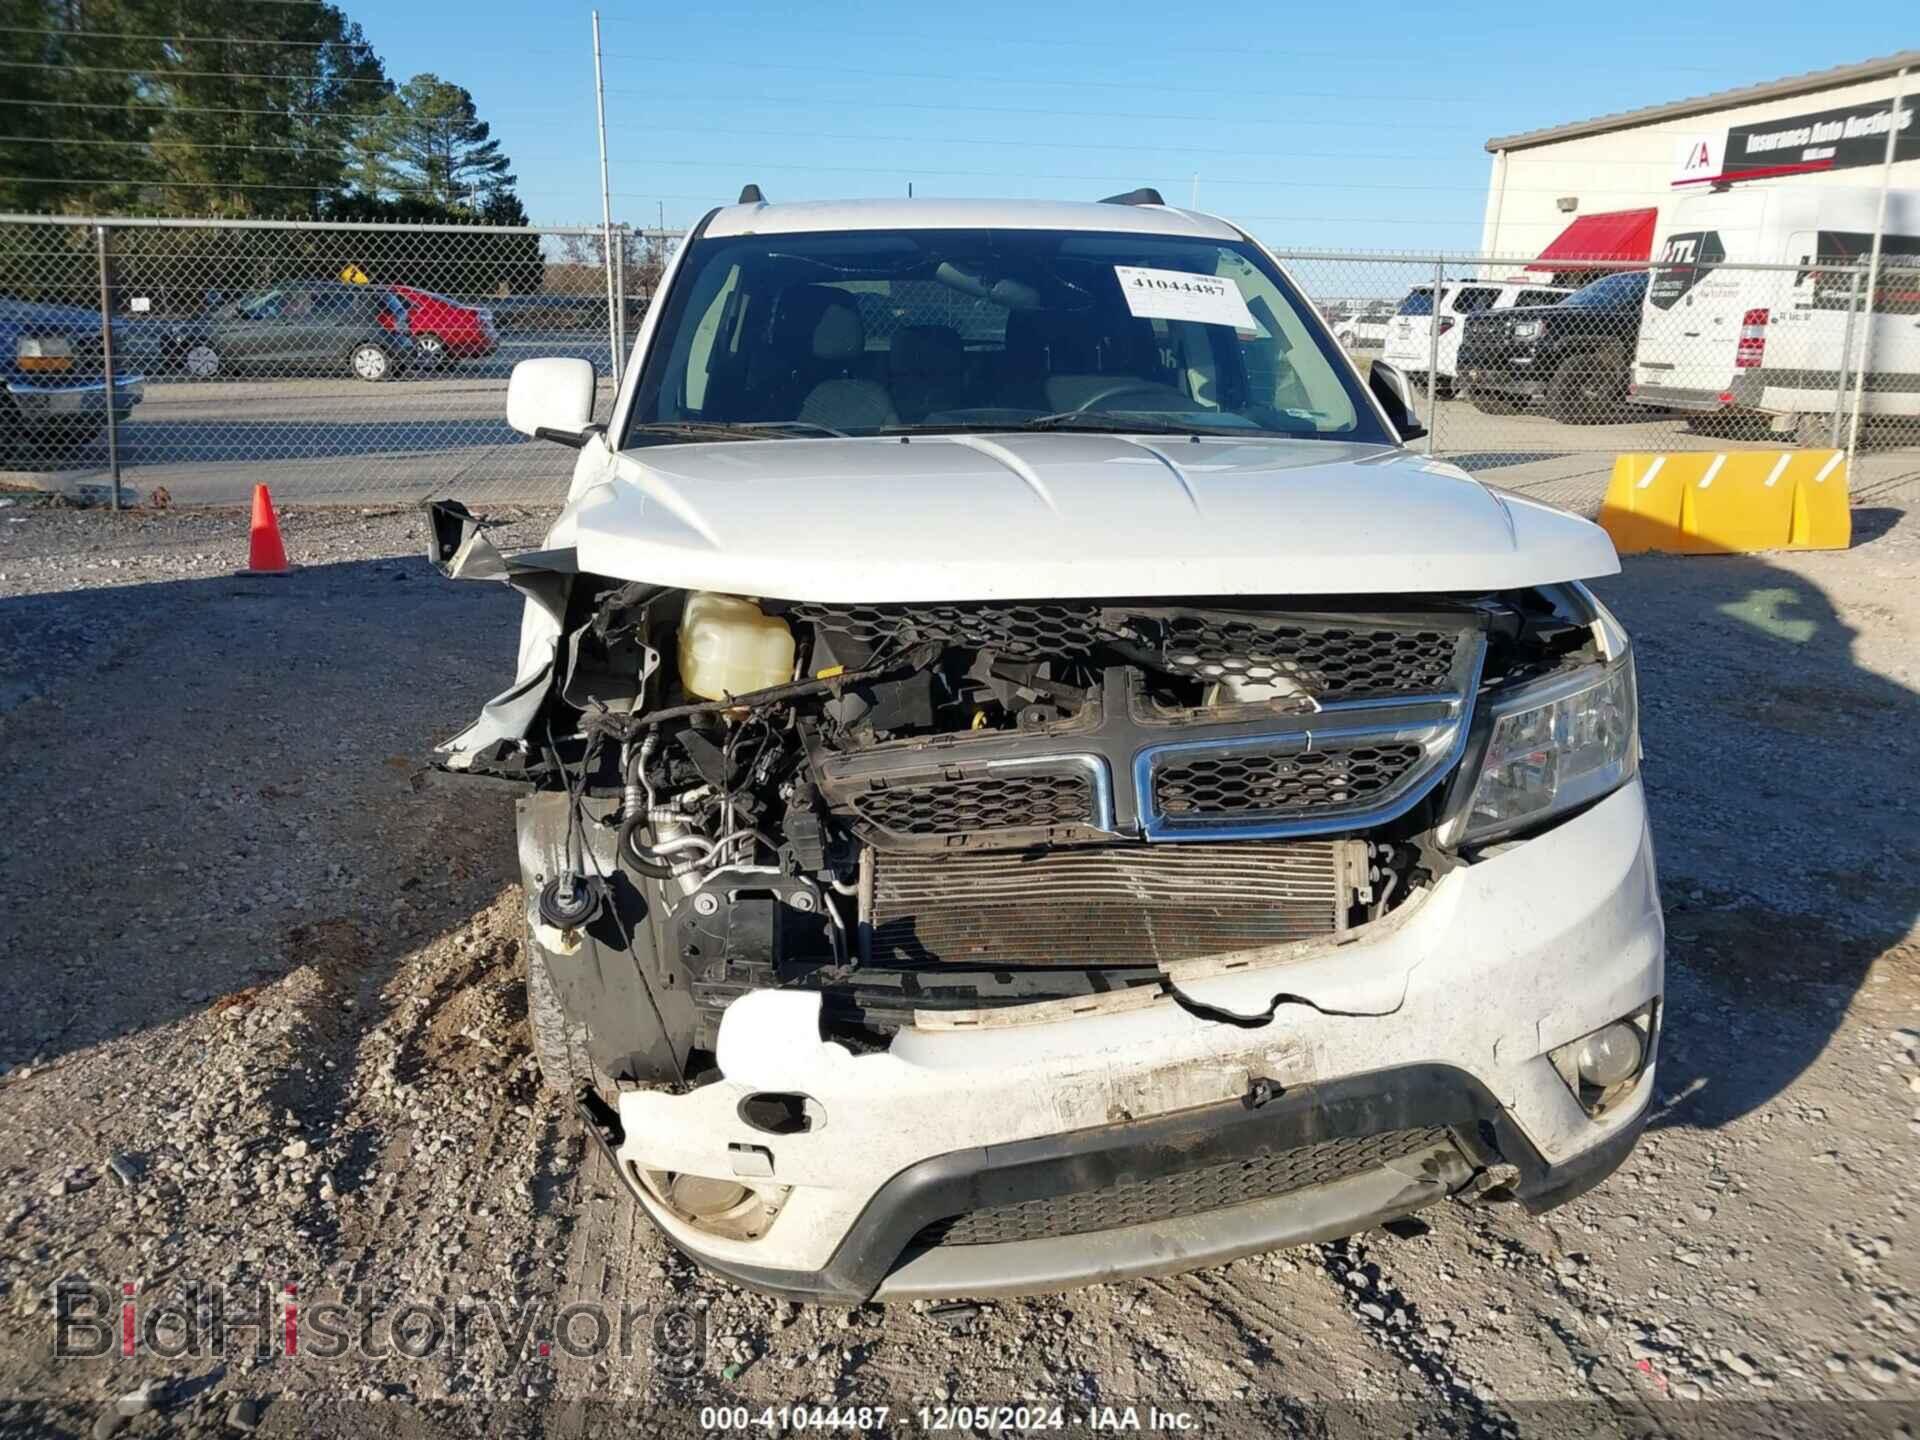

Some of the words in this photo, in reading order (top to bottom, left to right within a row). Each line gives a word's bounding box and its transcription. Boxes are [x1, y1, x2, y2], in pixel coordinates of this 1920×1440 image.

[1745, 127, 1812, 153] Insurance
[1809, 121, 1845, 144] Auto
[1133, 277, 1225, 297] 41044487
